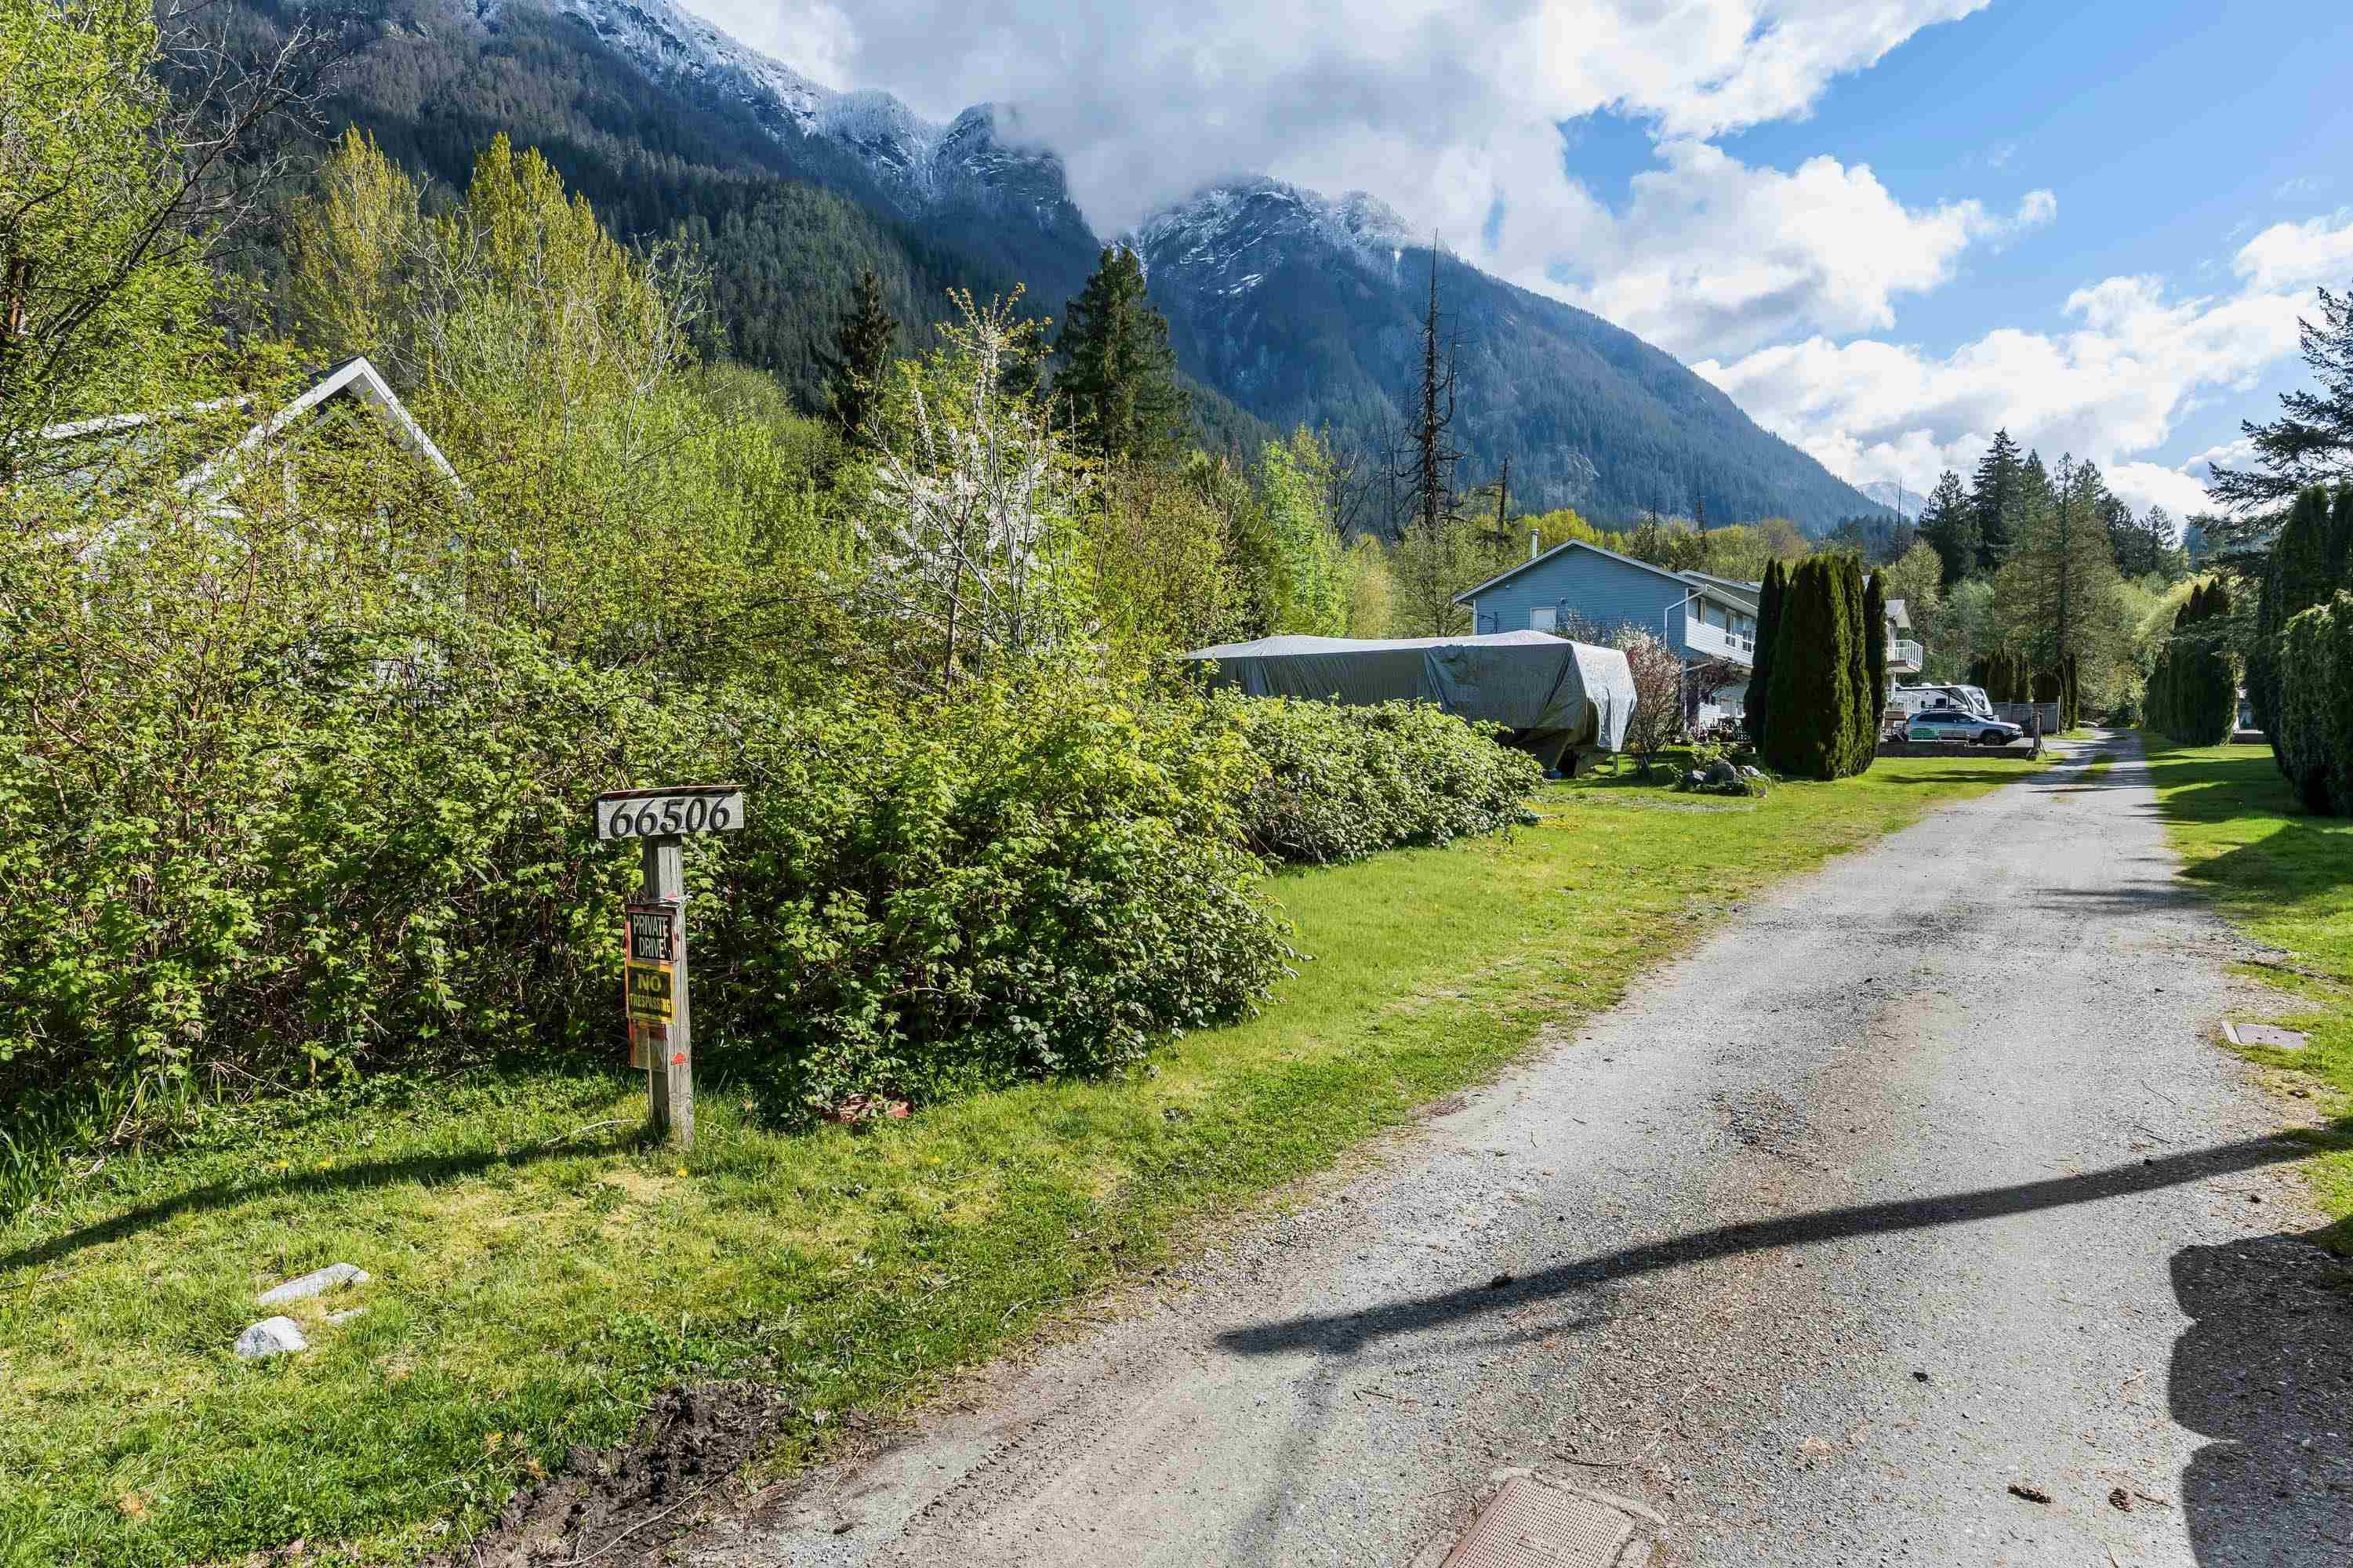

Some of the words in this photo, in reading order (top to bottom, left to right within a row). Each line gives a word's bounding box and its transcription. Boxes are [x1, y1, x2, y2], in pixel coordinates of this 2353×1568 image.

[609, 797, 730, 839] 66506
[634, 914, 669, 938] PRIVATE
[639, 936, 665, 958] DRIVE
[637, 974, 662, 992] NO
